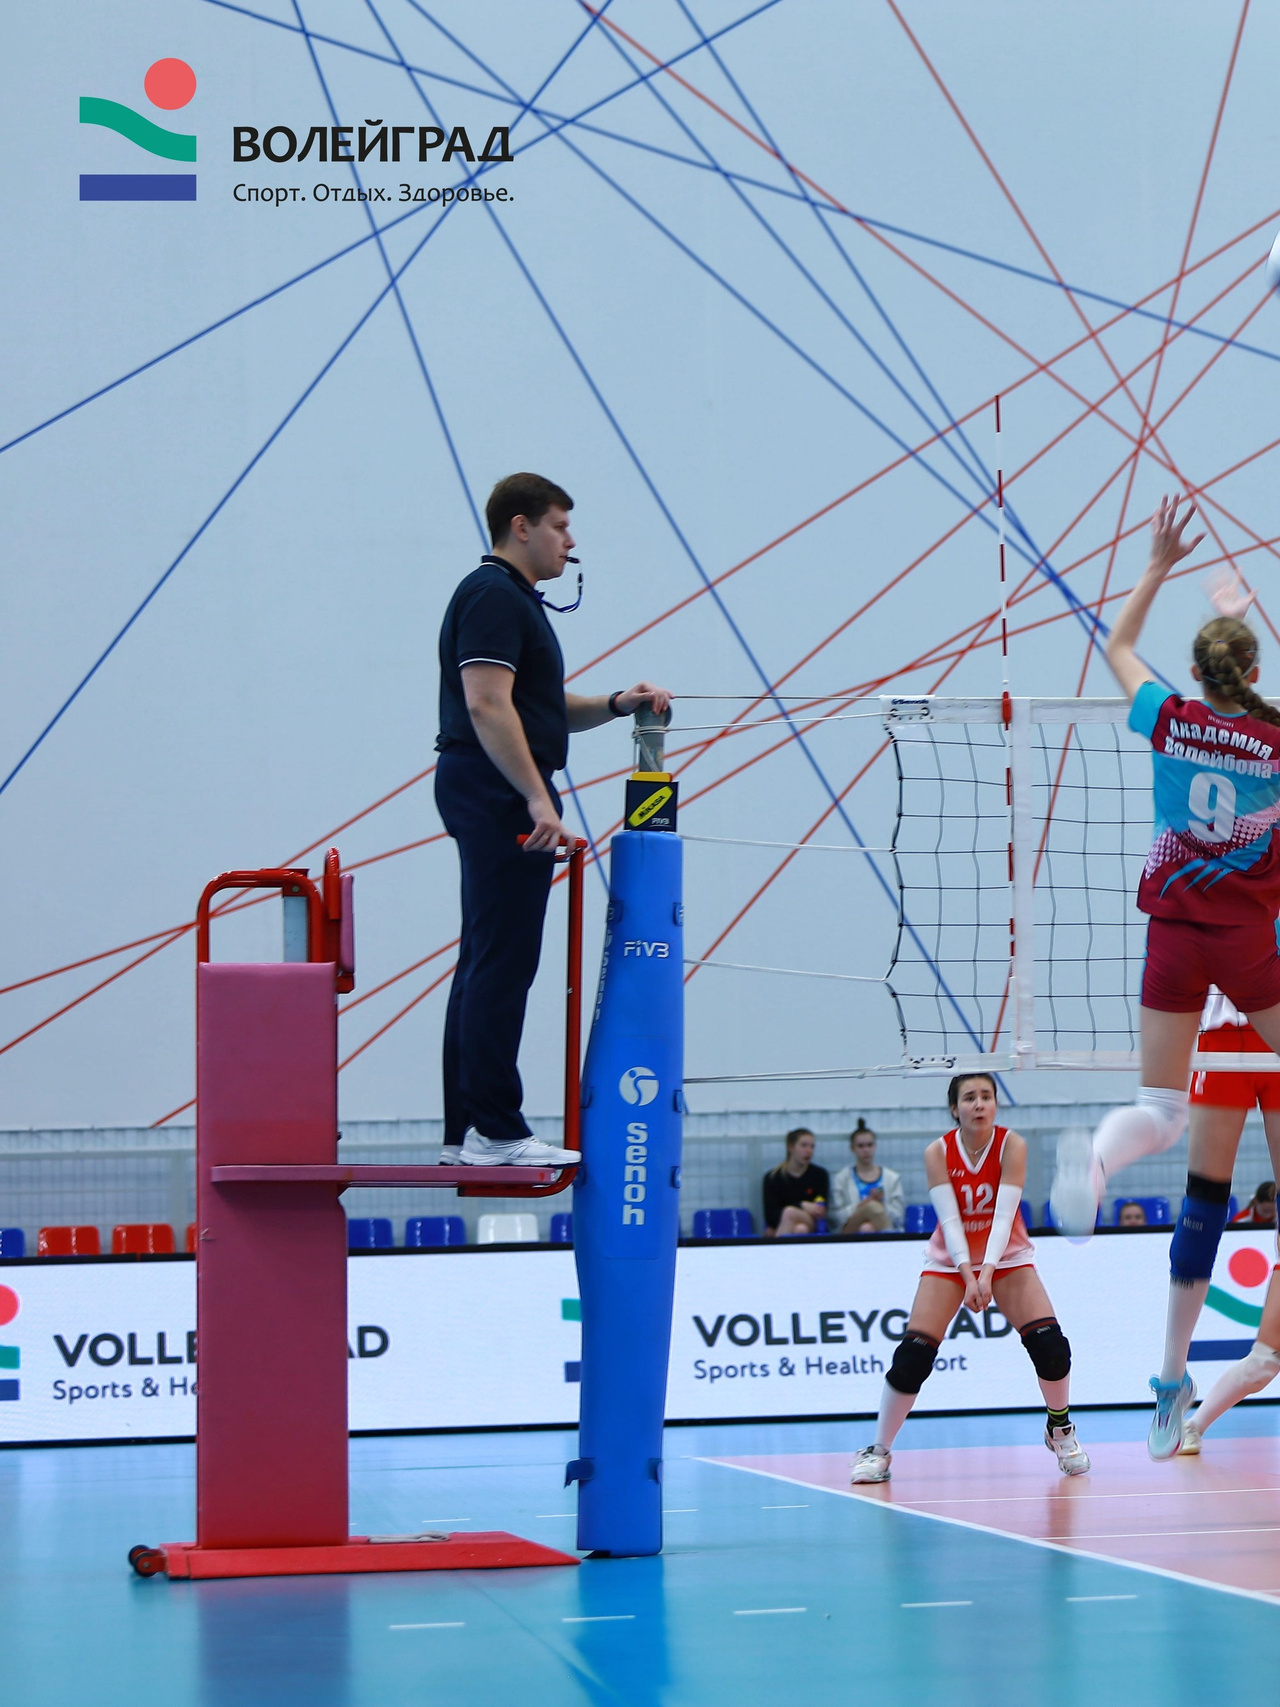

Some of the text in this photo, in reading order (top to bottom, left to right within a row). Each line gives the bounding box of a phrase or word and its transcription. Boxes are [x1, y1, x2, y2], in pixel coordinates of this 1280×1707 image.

[1187, 771, 1237, 844] 9
[621, 1121, 649, 1226] senoh
[960, 1182, 994, 1217] 12
[693, 1359, 770, 1384] Sports
[778, 1356, 796, 1377] &
[805, 1355, 885, 1376] Health
[53, 1380, 132, 1405] Sports
[141, 1377, 160, 1398] &
